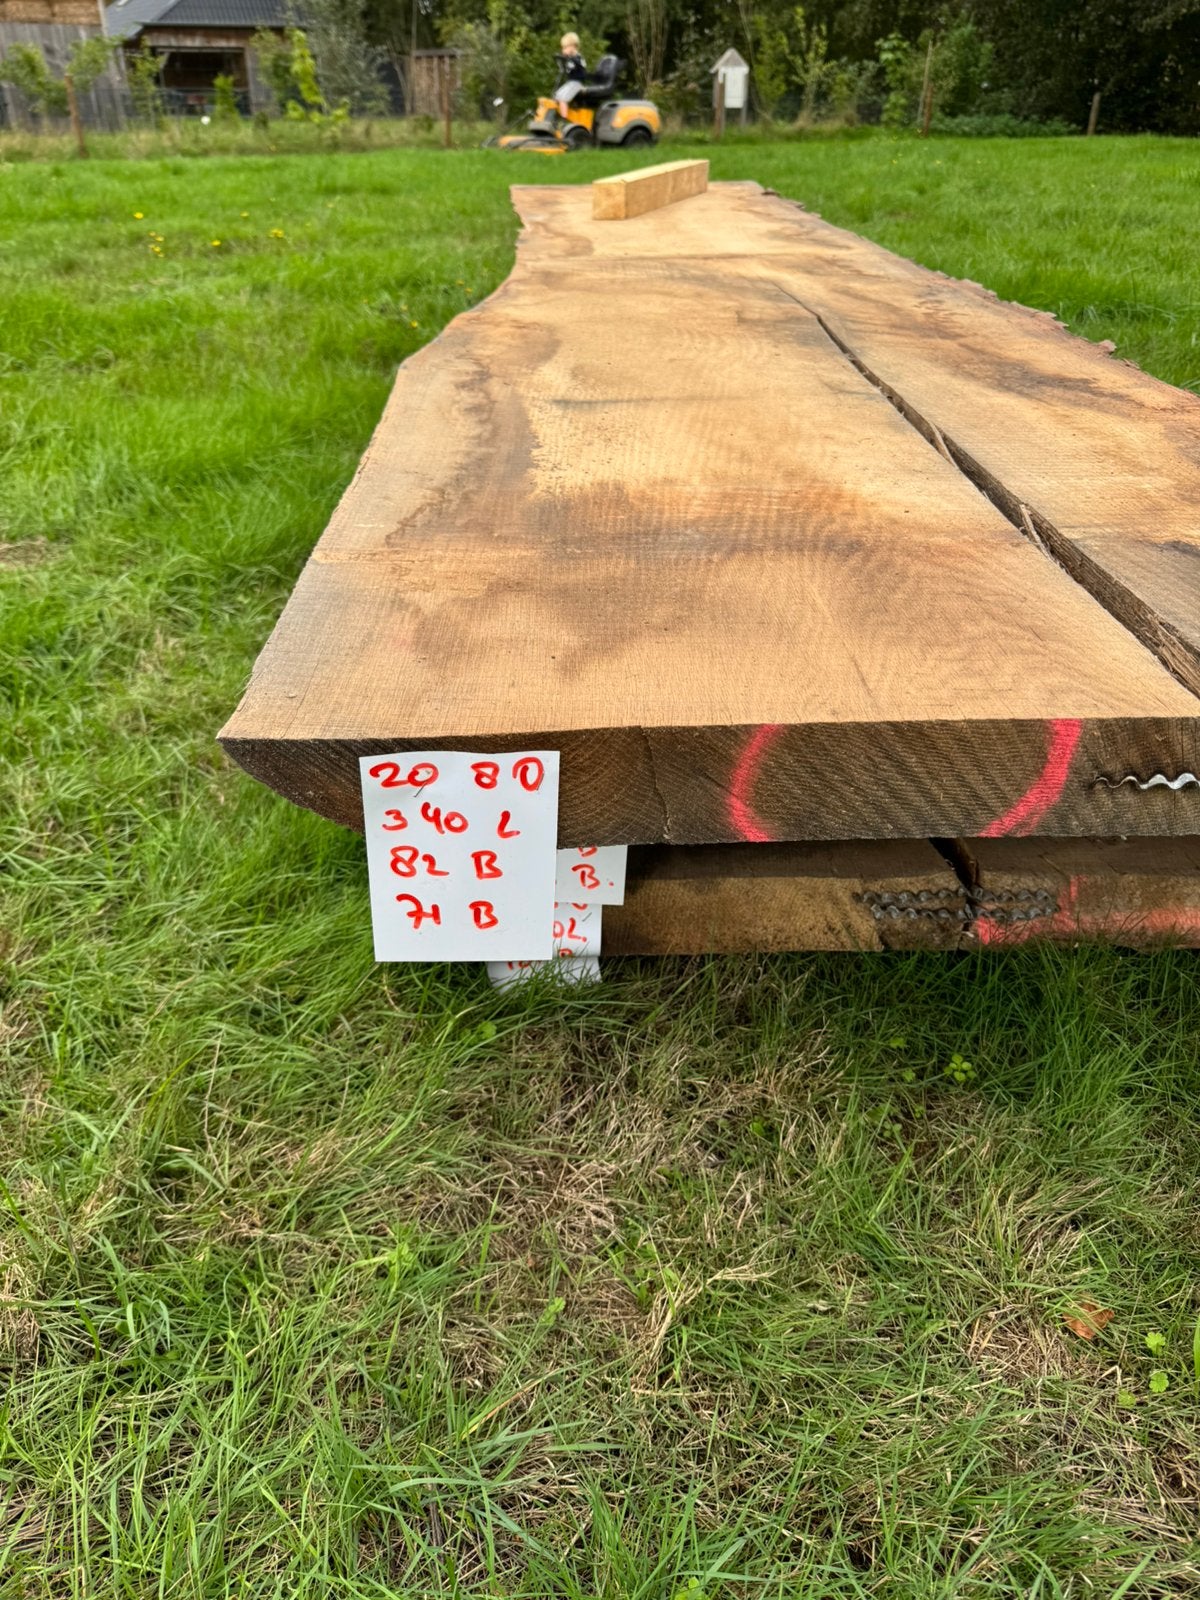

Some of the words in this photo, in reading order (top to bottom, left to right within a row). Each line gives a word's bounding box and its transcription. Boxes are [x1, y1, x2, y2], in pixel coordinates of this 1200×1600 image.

[368, 761, 440, 790] 20
[496, 810, 521, 839] L
[389, 844, 450, 879] 82
[470, 849, 503, 880] B
[468, 899, 499, 930] B
